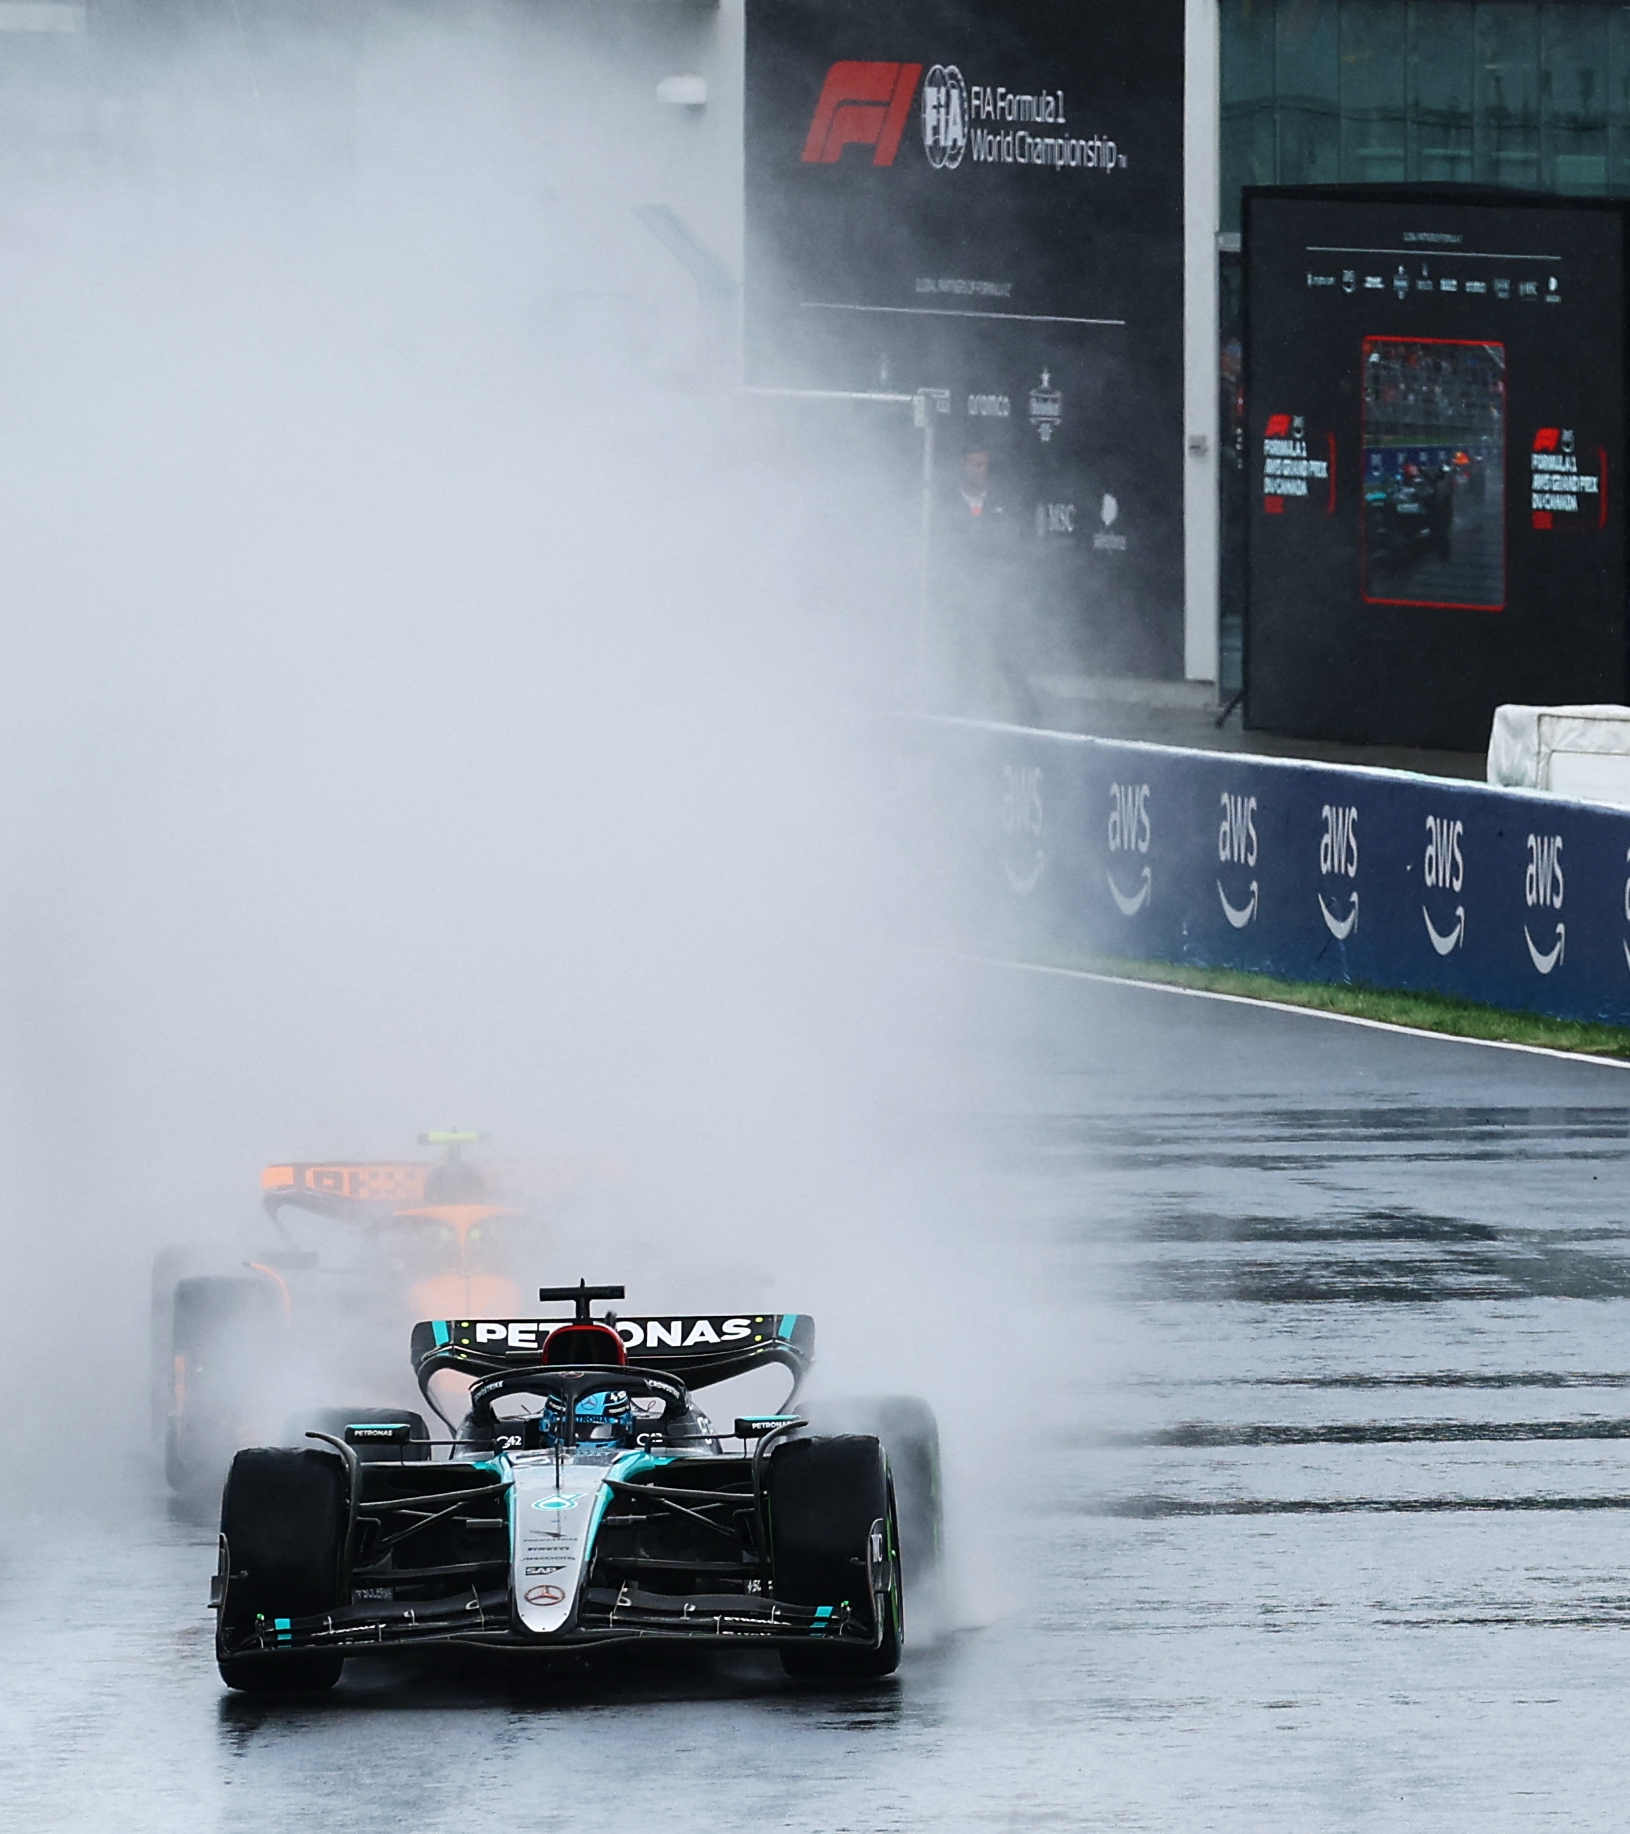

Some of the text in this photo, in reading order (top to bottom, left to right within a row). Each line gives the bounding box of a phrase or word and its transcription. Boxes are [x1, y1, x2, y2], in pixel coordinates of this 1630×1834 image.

[971, 86, 1067, 124] FIA Formula 1
[971, 128, 1014, 162] World
[1015, 130, 1118, 174] Championship
[1109, 781, 1150, 853] aws
[1219, 791, 1258, 867] aws
[1320, 804, 1358, 878] aws
[1424, 815, 1464, 892] aws
[1526, 833, 1564, 909] aws
[476, 1318, 752, 1349] PETONAS
[354, 1429, 393, 1437] PETRONAS
[526, 1567, 557, 1575] SAP
